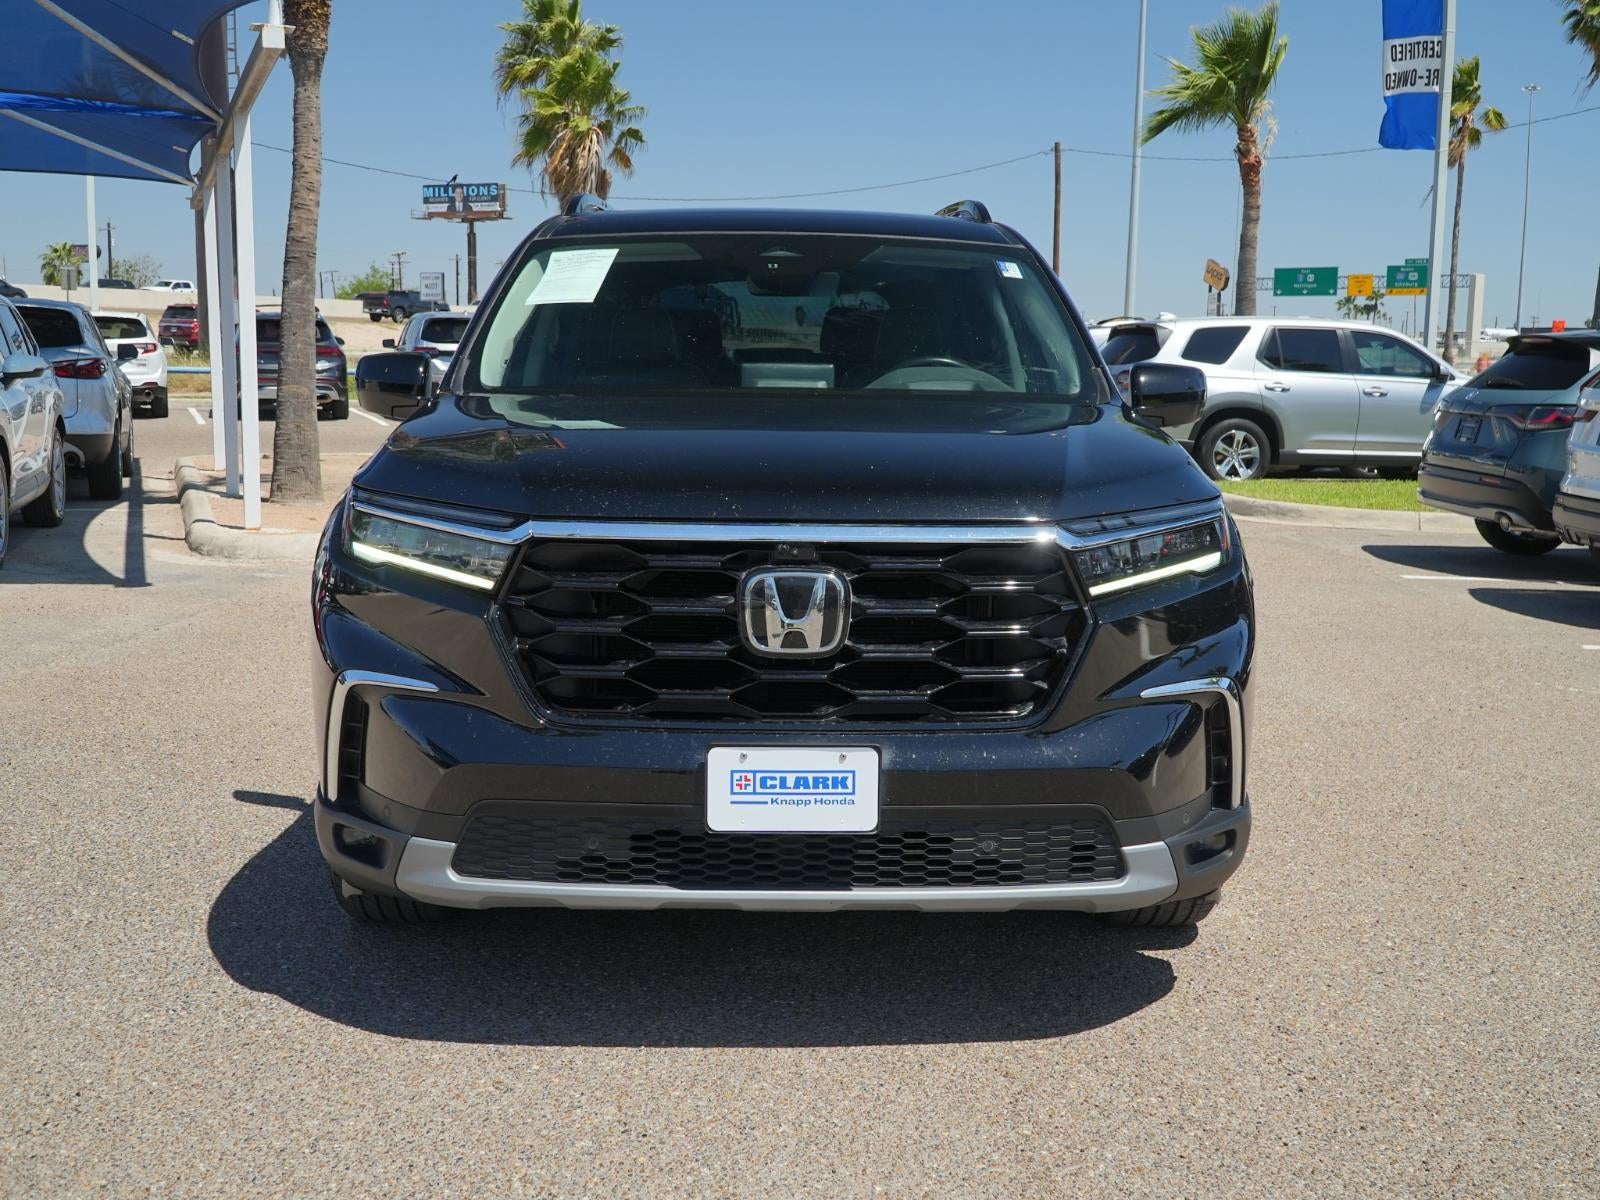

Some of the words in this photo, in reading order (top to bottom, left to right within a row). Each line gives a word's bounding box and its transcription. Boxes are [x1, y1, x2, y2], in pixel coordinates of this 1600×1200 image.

[423, 185, 498, 198] MILLIONS
[759, 776, 850, 790] CLARK
[770, 797, 812, 807] Knapp
[814, 797, 856, 806] Honda
